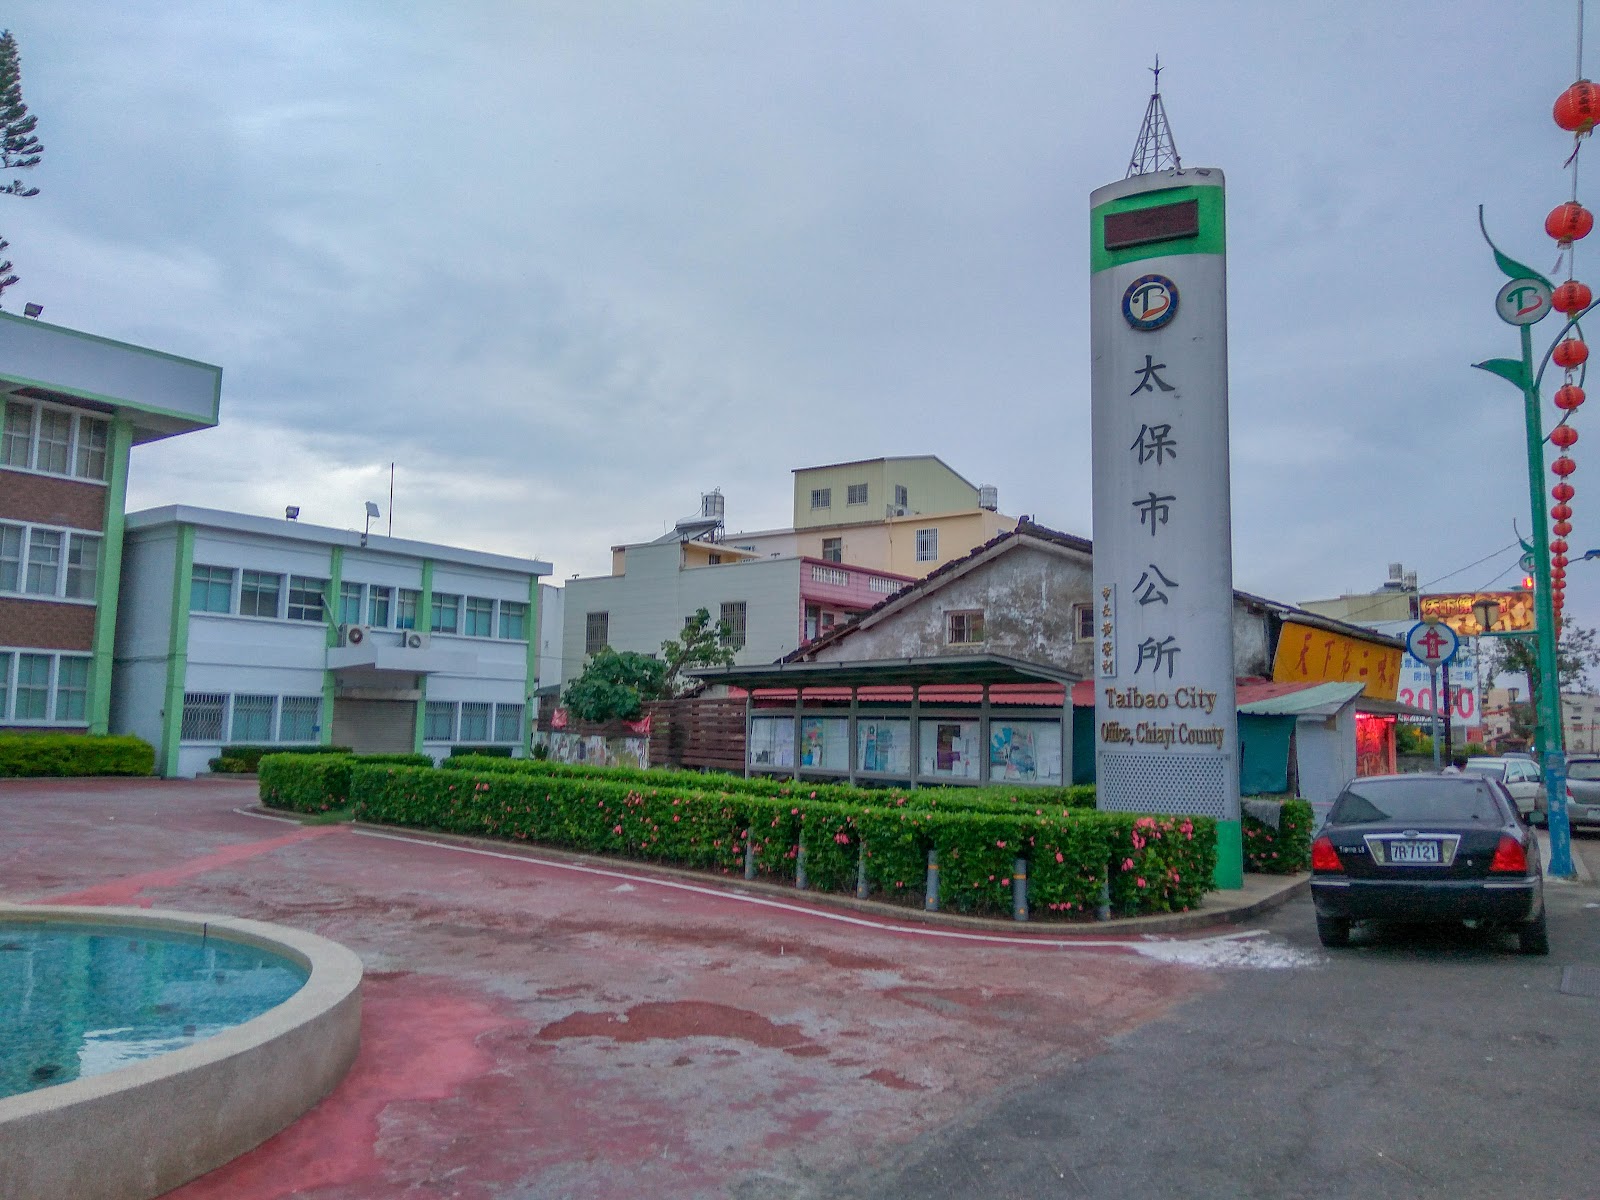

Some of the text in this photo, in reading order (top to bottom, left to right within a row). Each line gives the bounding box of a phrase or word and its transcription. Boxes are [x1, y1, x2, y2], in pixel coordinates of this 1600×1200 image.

[1130, 354, 1182, 679] 太保市公所
[1105, 686, 1217, 714] Taibao City
[1136, 721, 1175, 750] Chiayi
[1179, 722, 1224, 750] County
